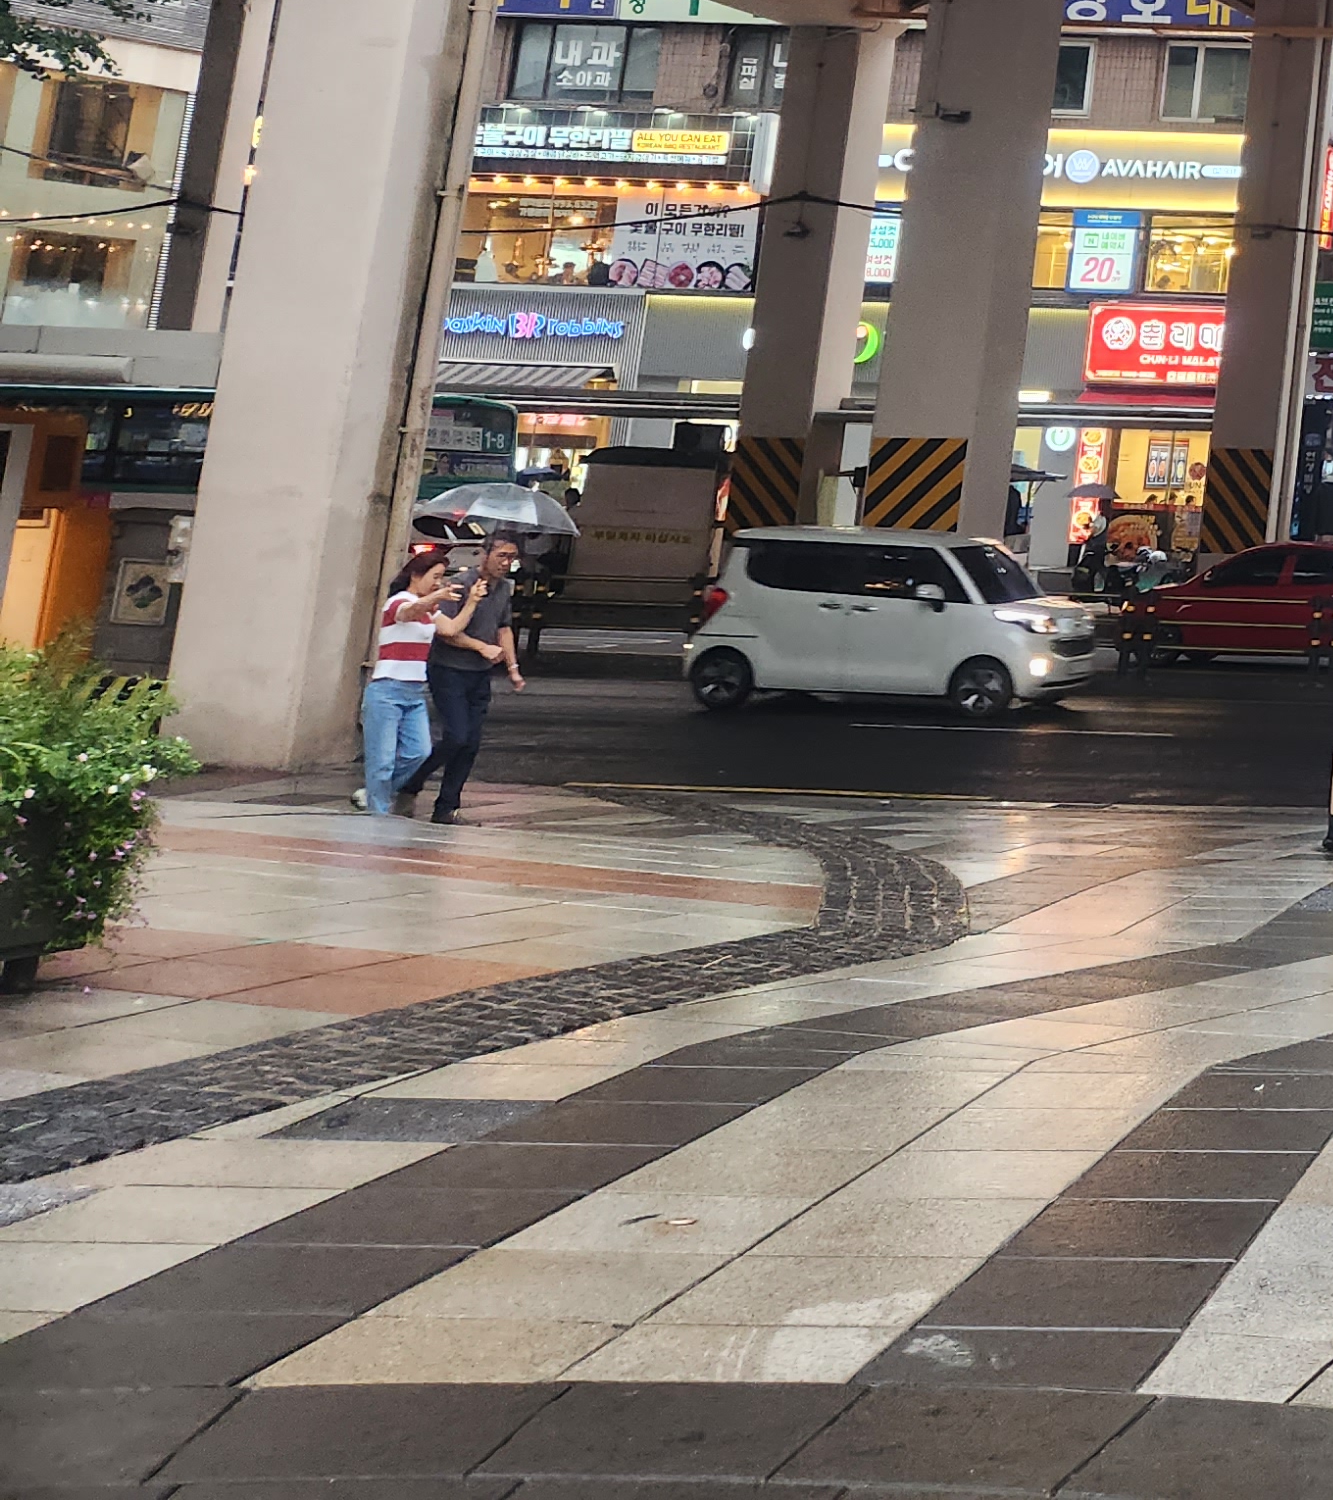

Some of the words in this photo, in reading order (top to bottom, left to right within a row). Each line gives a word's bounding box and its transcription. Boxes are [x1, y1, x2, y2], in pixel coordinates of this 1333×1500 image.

[554, 40, 621, 68] 내과
[555, 71, 612, 88] 소아과
[549, 126, 633, 151] 무한리필
[637, 132, 655, 143] ALL
[659, 133, 678, 143] YOU
[703, 134, 723, 144] EAT
[1101, 160, 1201, 181] AVAHAIR
[1080, 256, 1116, 283] 20
